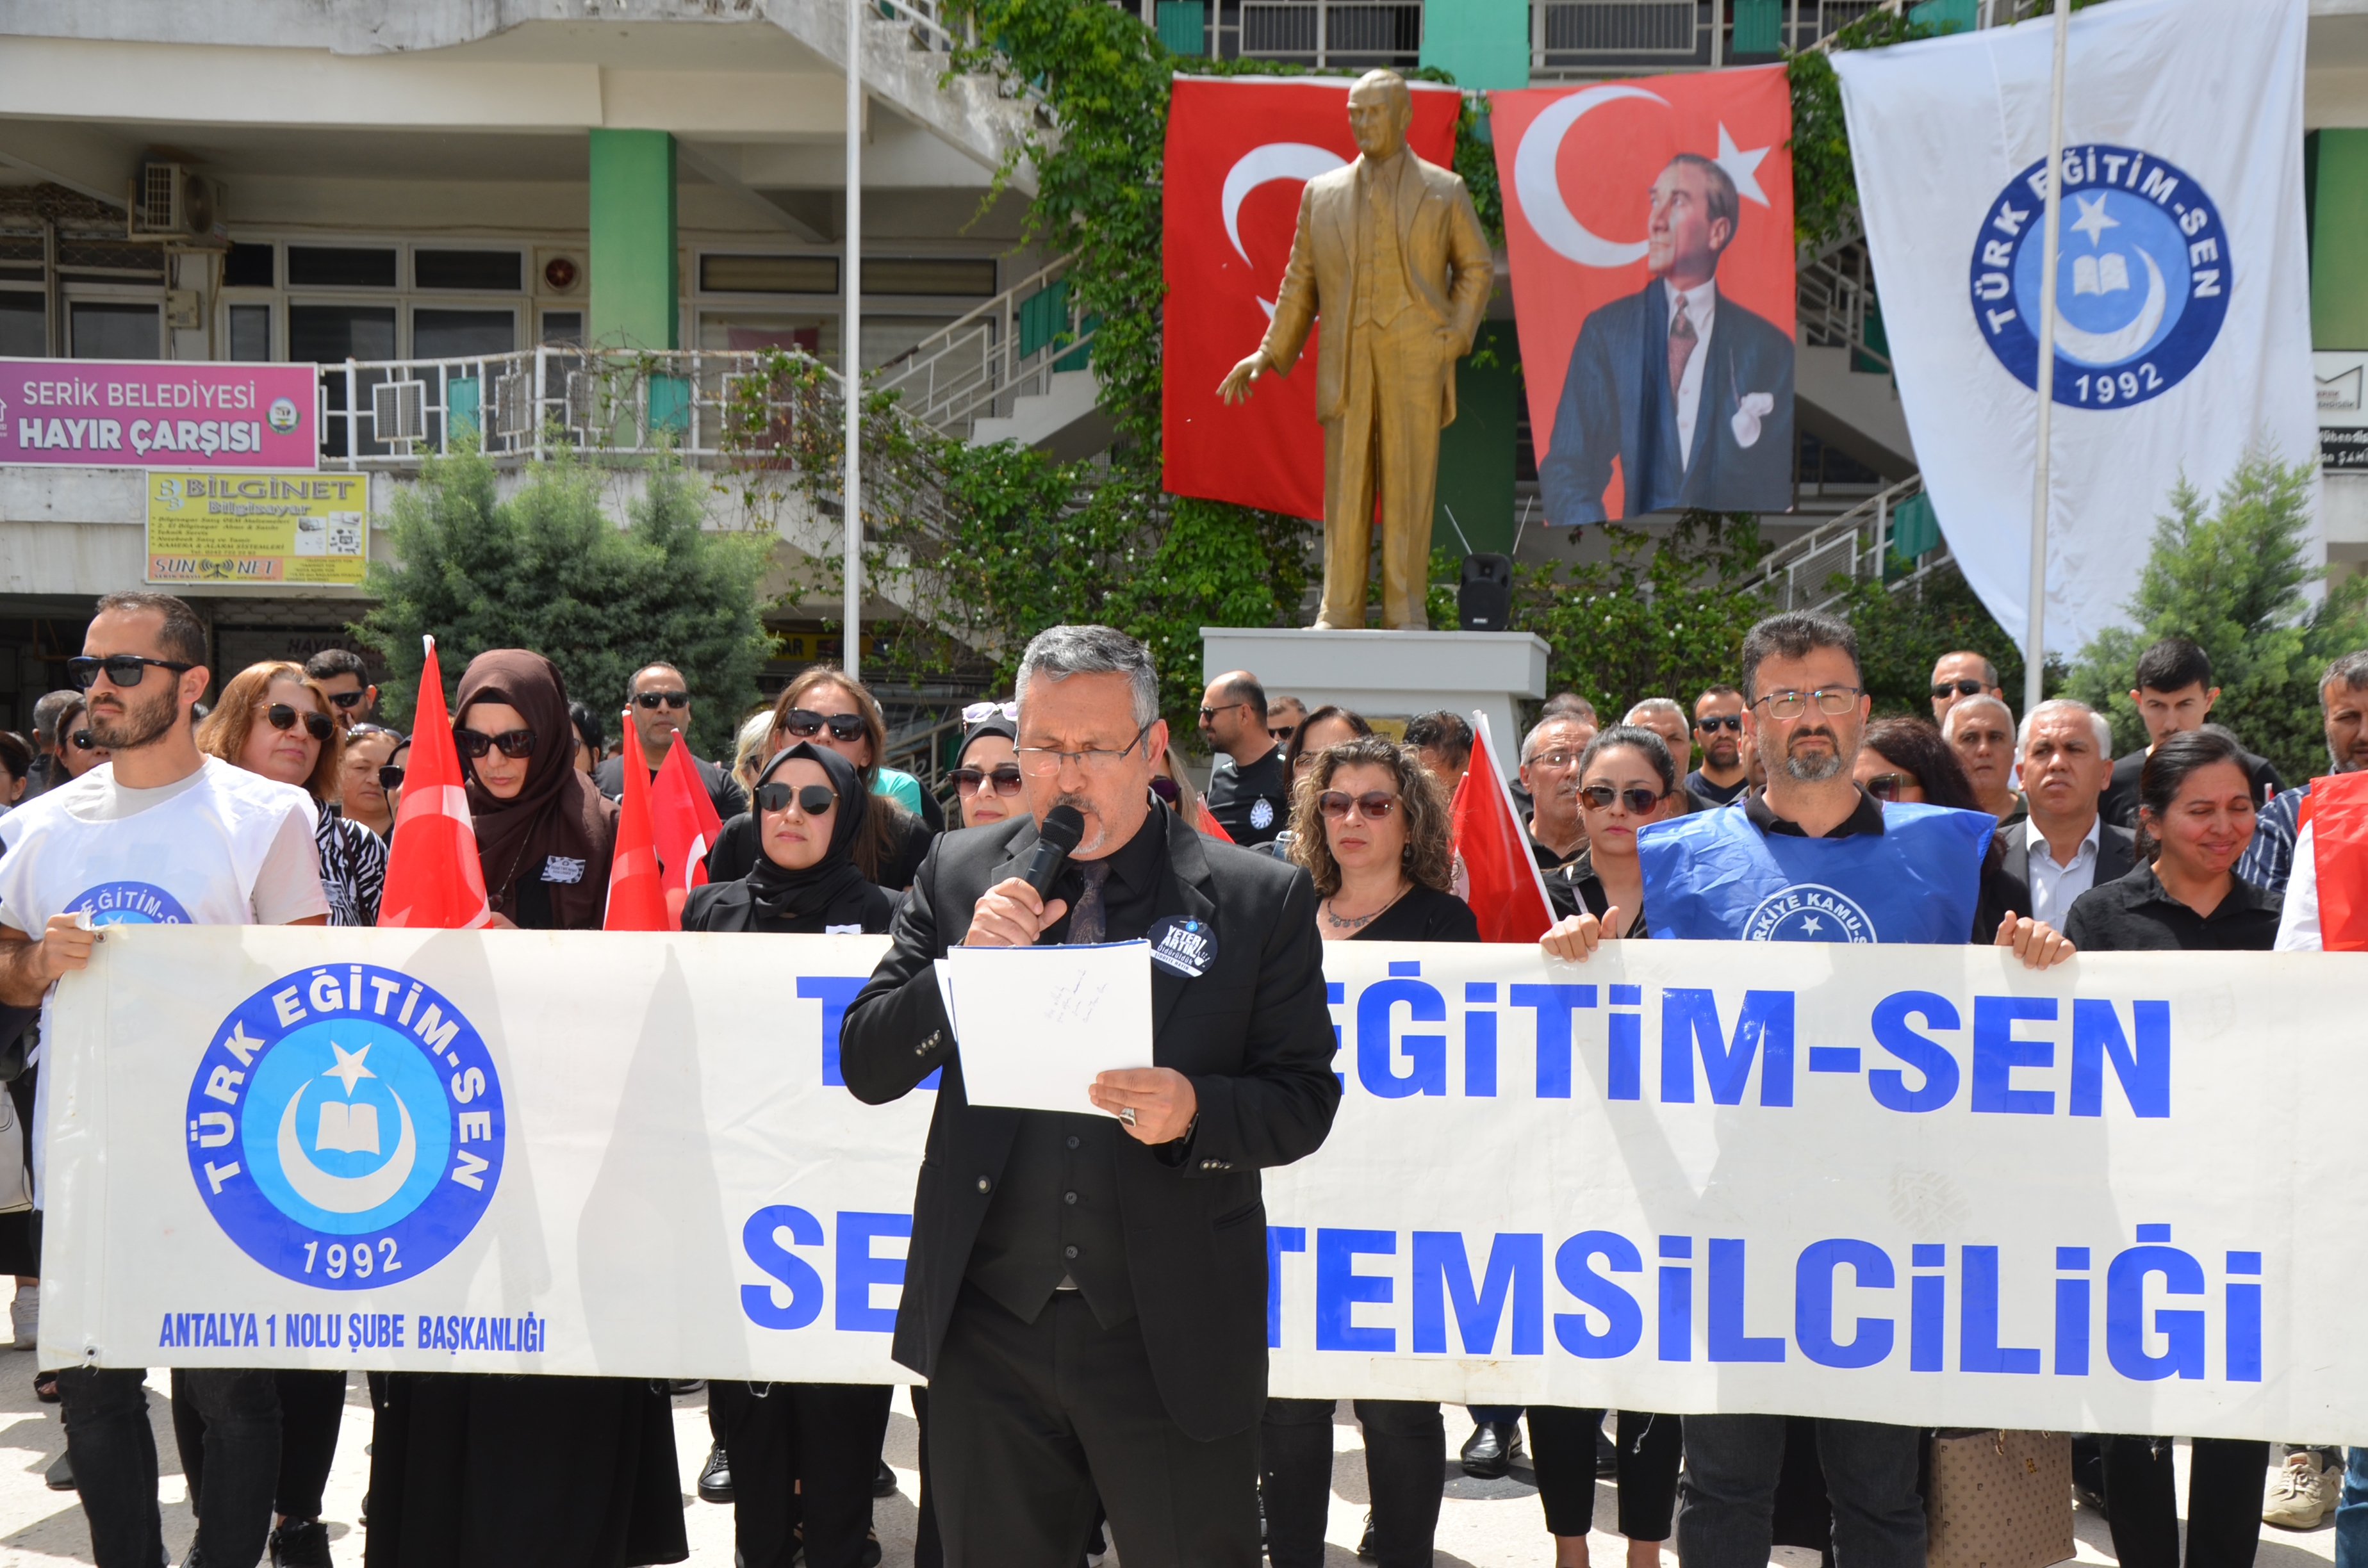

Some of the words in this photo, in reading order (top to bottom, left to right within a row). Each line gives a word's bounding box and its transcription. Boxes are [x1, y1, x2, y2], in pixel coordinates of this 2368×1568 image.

[1974, 200, 2030, 335] TÜRK
[2027, 146, 2221, 298] EĞİTİM-SEN
[23, 377, 99, 407] SERİK
[108, 379, 256, 409] BELEDİYESİ
[2075, 362, 2164, 404] 1992
[19, 418, 122, 450] HAYIR
[129, 420, 261, 457] ÇARŞISI
[186, 475, 355, 500] BİLGİNET
[208, 500, 311, 516] Bilgisayar
[155, 558, 196, 573] SUN
[237, 559, 277, 575] NET
[81, 886, 179, 924] EĞİTİM-S
[1752, 894, 1801, 942] RKİYE
[1807, 893, 1868, 943] KAMU-S
[1167, 924, 1202, 948] YETER
[1174, 960, 1189, 971] HAYIR
[191, 1019, 265, 1195] TÜRK
[272, 965, 492, 1191] EĞİTİM-SEN
[303, 1237, 402, 1279] 1992
[159, 1312, 258, 1348] ANTALYA
[266, 1314, 275, 1348] 1
[286, 1314, 341, 1348] NOLU
[349, 1313, 405, 1353] ŞUBE
[418, 1311, 545, 1355] BAŞKANLIĞI
